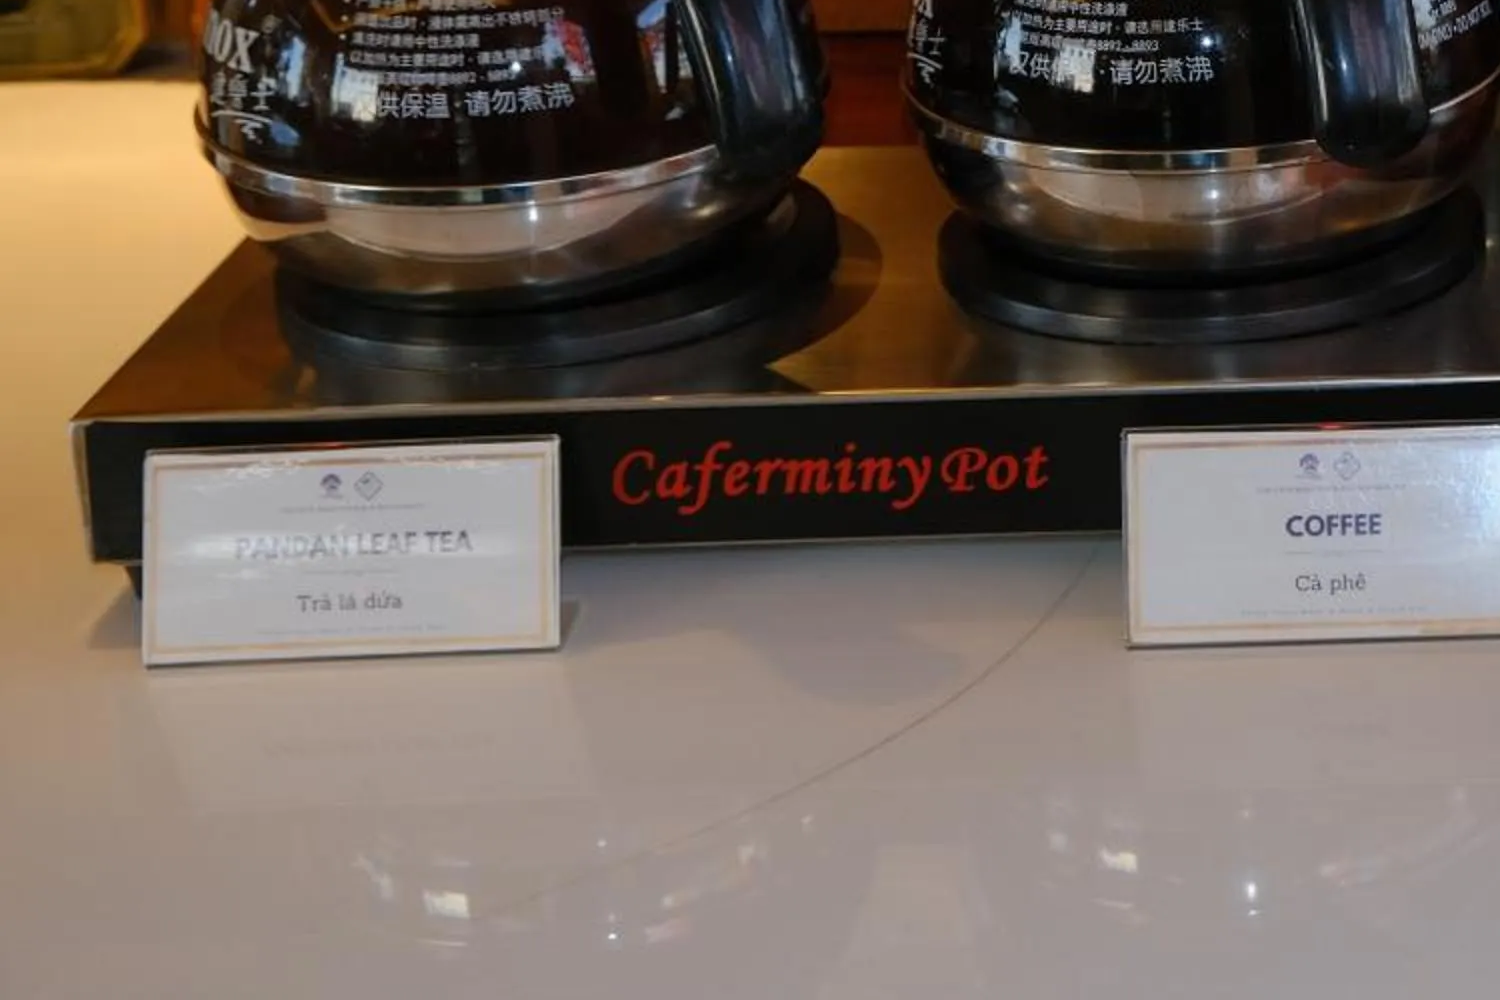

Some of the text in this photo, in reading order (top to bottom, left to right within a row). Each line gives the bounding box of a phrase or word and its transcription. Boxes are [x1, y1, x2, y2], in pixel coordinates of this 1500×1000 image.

[1285, 513, 1383, 538] COFFEE
[235, 530, 474, 560] PANDAN LEAF TEA
[1330, 572, 1367, 596] phê
